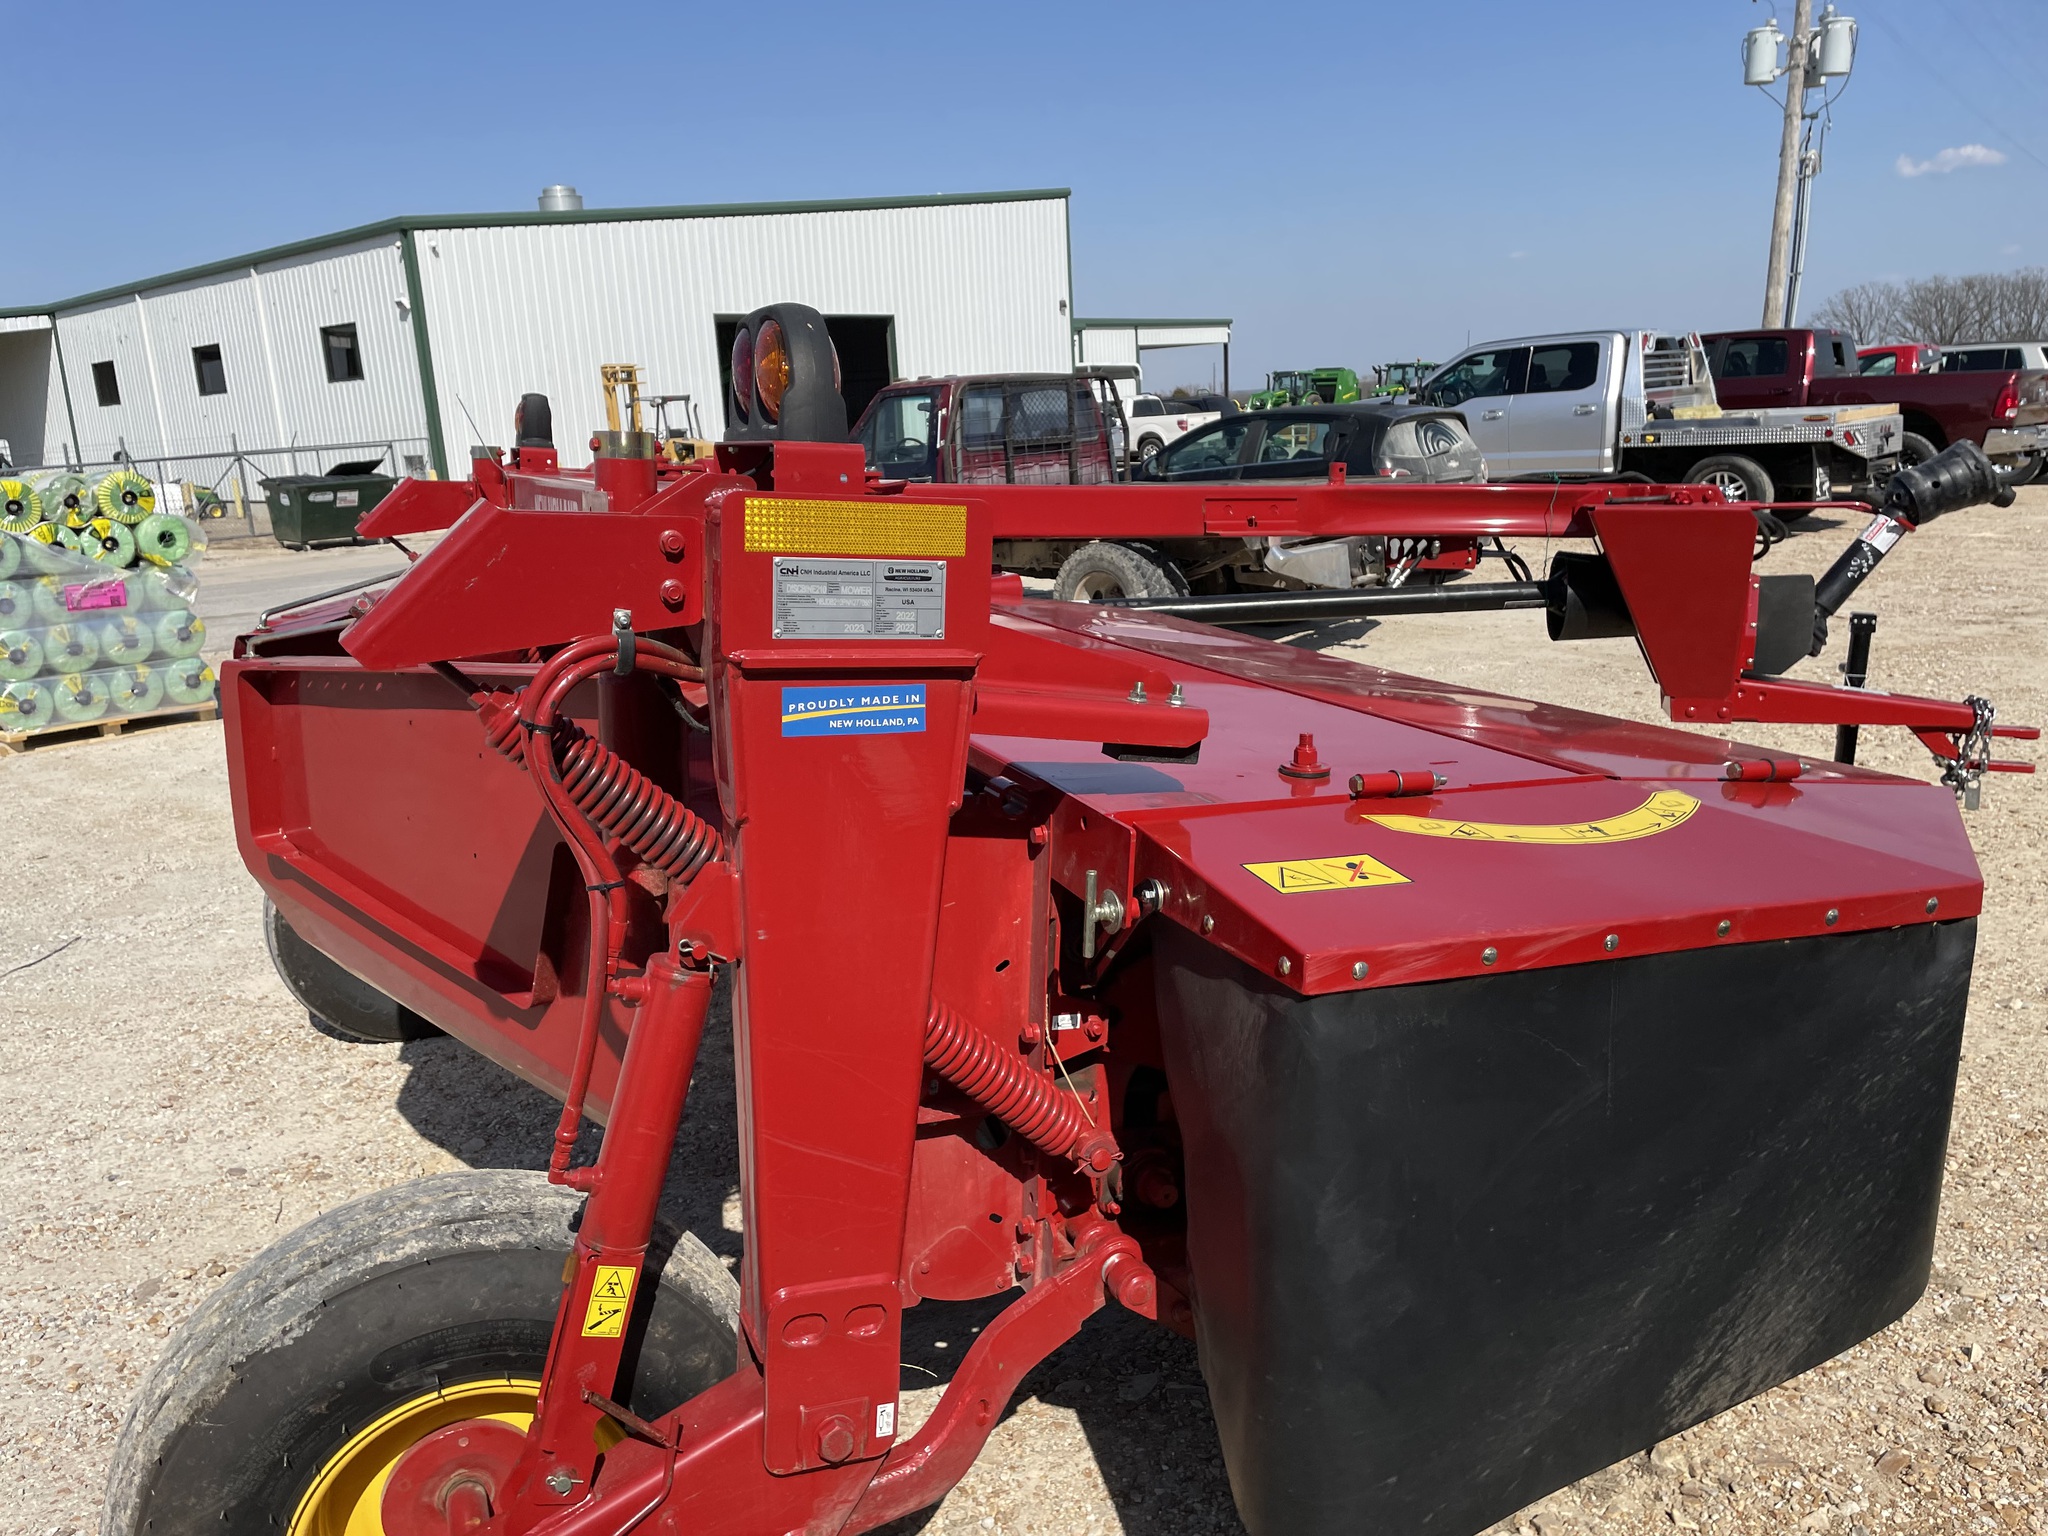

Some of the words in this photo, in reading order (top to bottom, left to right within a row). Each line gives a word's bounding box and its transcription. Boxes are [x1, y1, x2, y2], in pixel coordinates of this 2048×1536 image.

[840, 586, 872, 595] MOWER
[896, 611, 915, 620] 2022
[844, 624, 865, 633] 2023
[895, 623, 915, 632] 2022
[788, 697, 855, 713] PROUDLY
[861, 695, 899, 705] MADE
[905, 694, 920, 703] IN
[829, 719, 854, 728] NEW
[856, 718, 905, 728] HOLLAND,
[907, 717, 919, 725] PA
